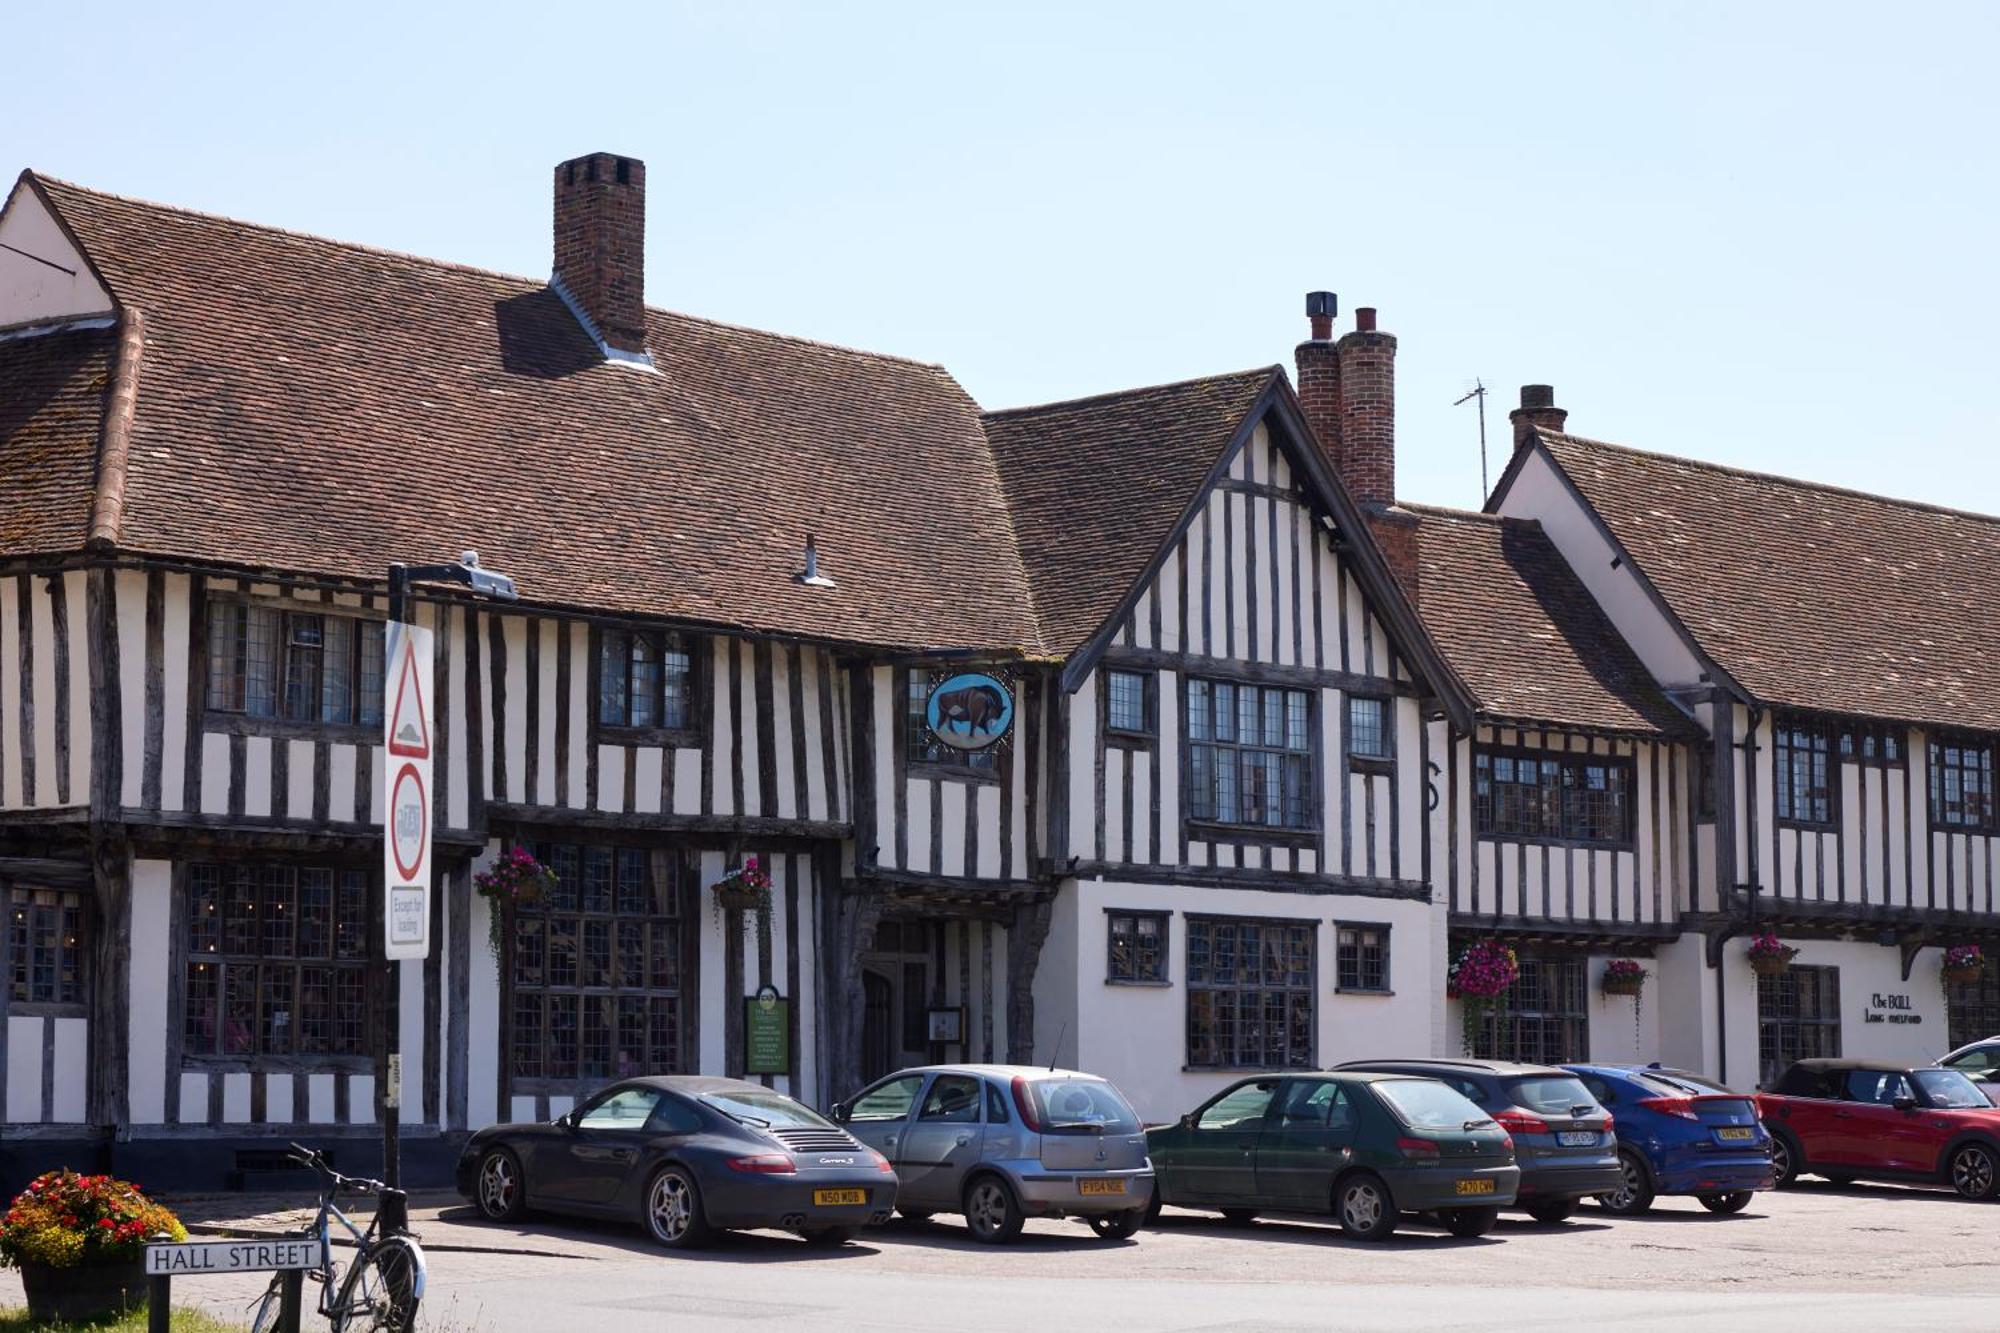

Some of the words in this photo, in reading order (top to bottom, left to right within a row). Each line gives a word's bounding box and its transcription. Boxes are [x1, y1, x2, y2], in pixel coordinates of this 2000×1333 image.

[1888, 994, 1911, 1010] BULL
[847, 1157, 854, 1165] S
[820, 1190, 840, 1203] N50
[155, 1248, 215, 1270] HALL
[230, 1244, 314, 1268] STREET
